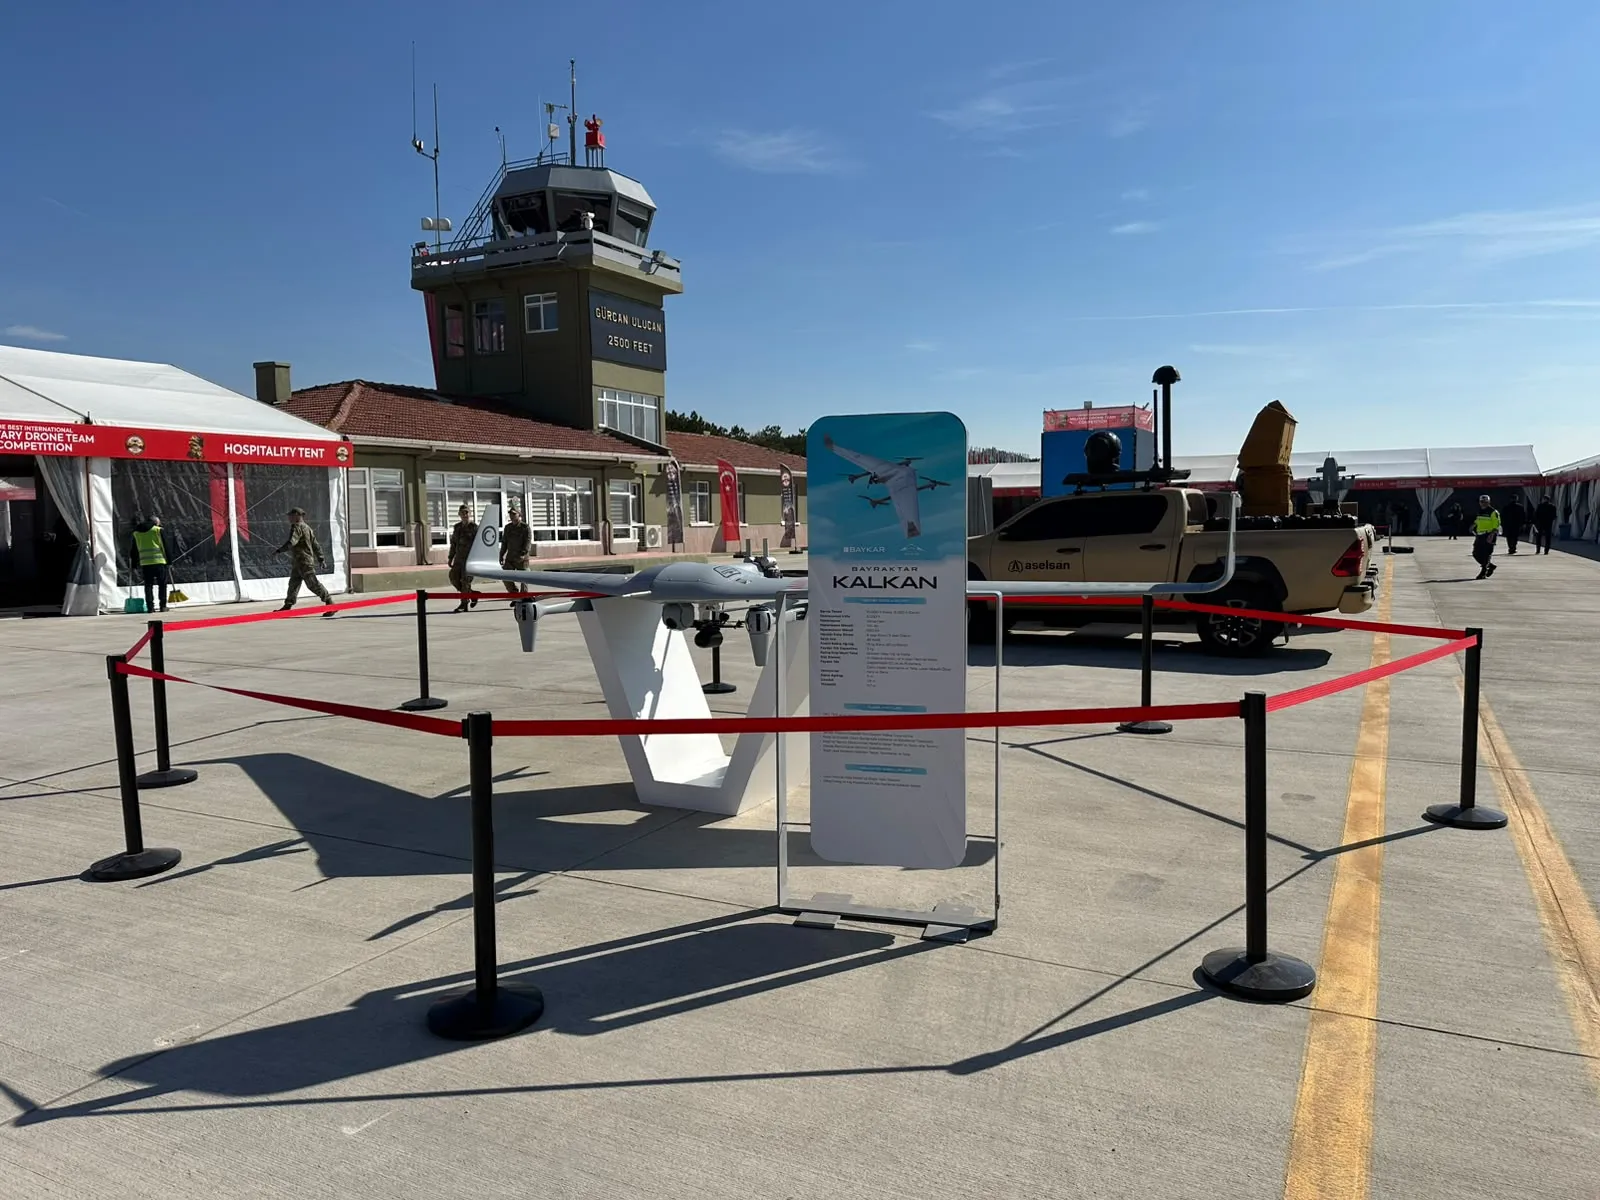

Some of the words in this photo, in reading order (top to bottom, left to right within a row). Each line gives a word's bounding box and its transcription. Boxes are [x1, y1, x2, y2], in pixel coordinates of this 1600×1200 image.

[595, 306, 628, 325] GÜRCAN
[632, 317, 662, 333] ULUCAN
[608, 335, 630, 348] 2500
[633, 341, 653, 353] FEET
[0, 430, 22, 440] ARY
[25, 432, 64, 442] DRONE
[66, 434, 94, 443] TEAM
[0, 440, 73, 452] COMPETITION
[224, 443, 296, 458] HOSPITALITY
[298, 447, 325, 459] TENT
[1025, 560, 1070, 570] aselsan
[833, 576, 937, 589] KALKAN
